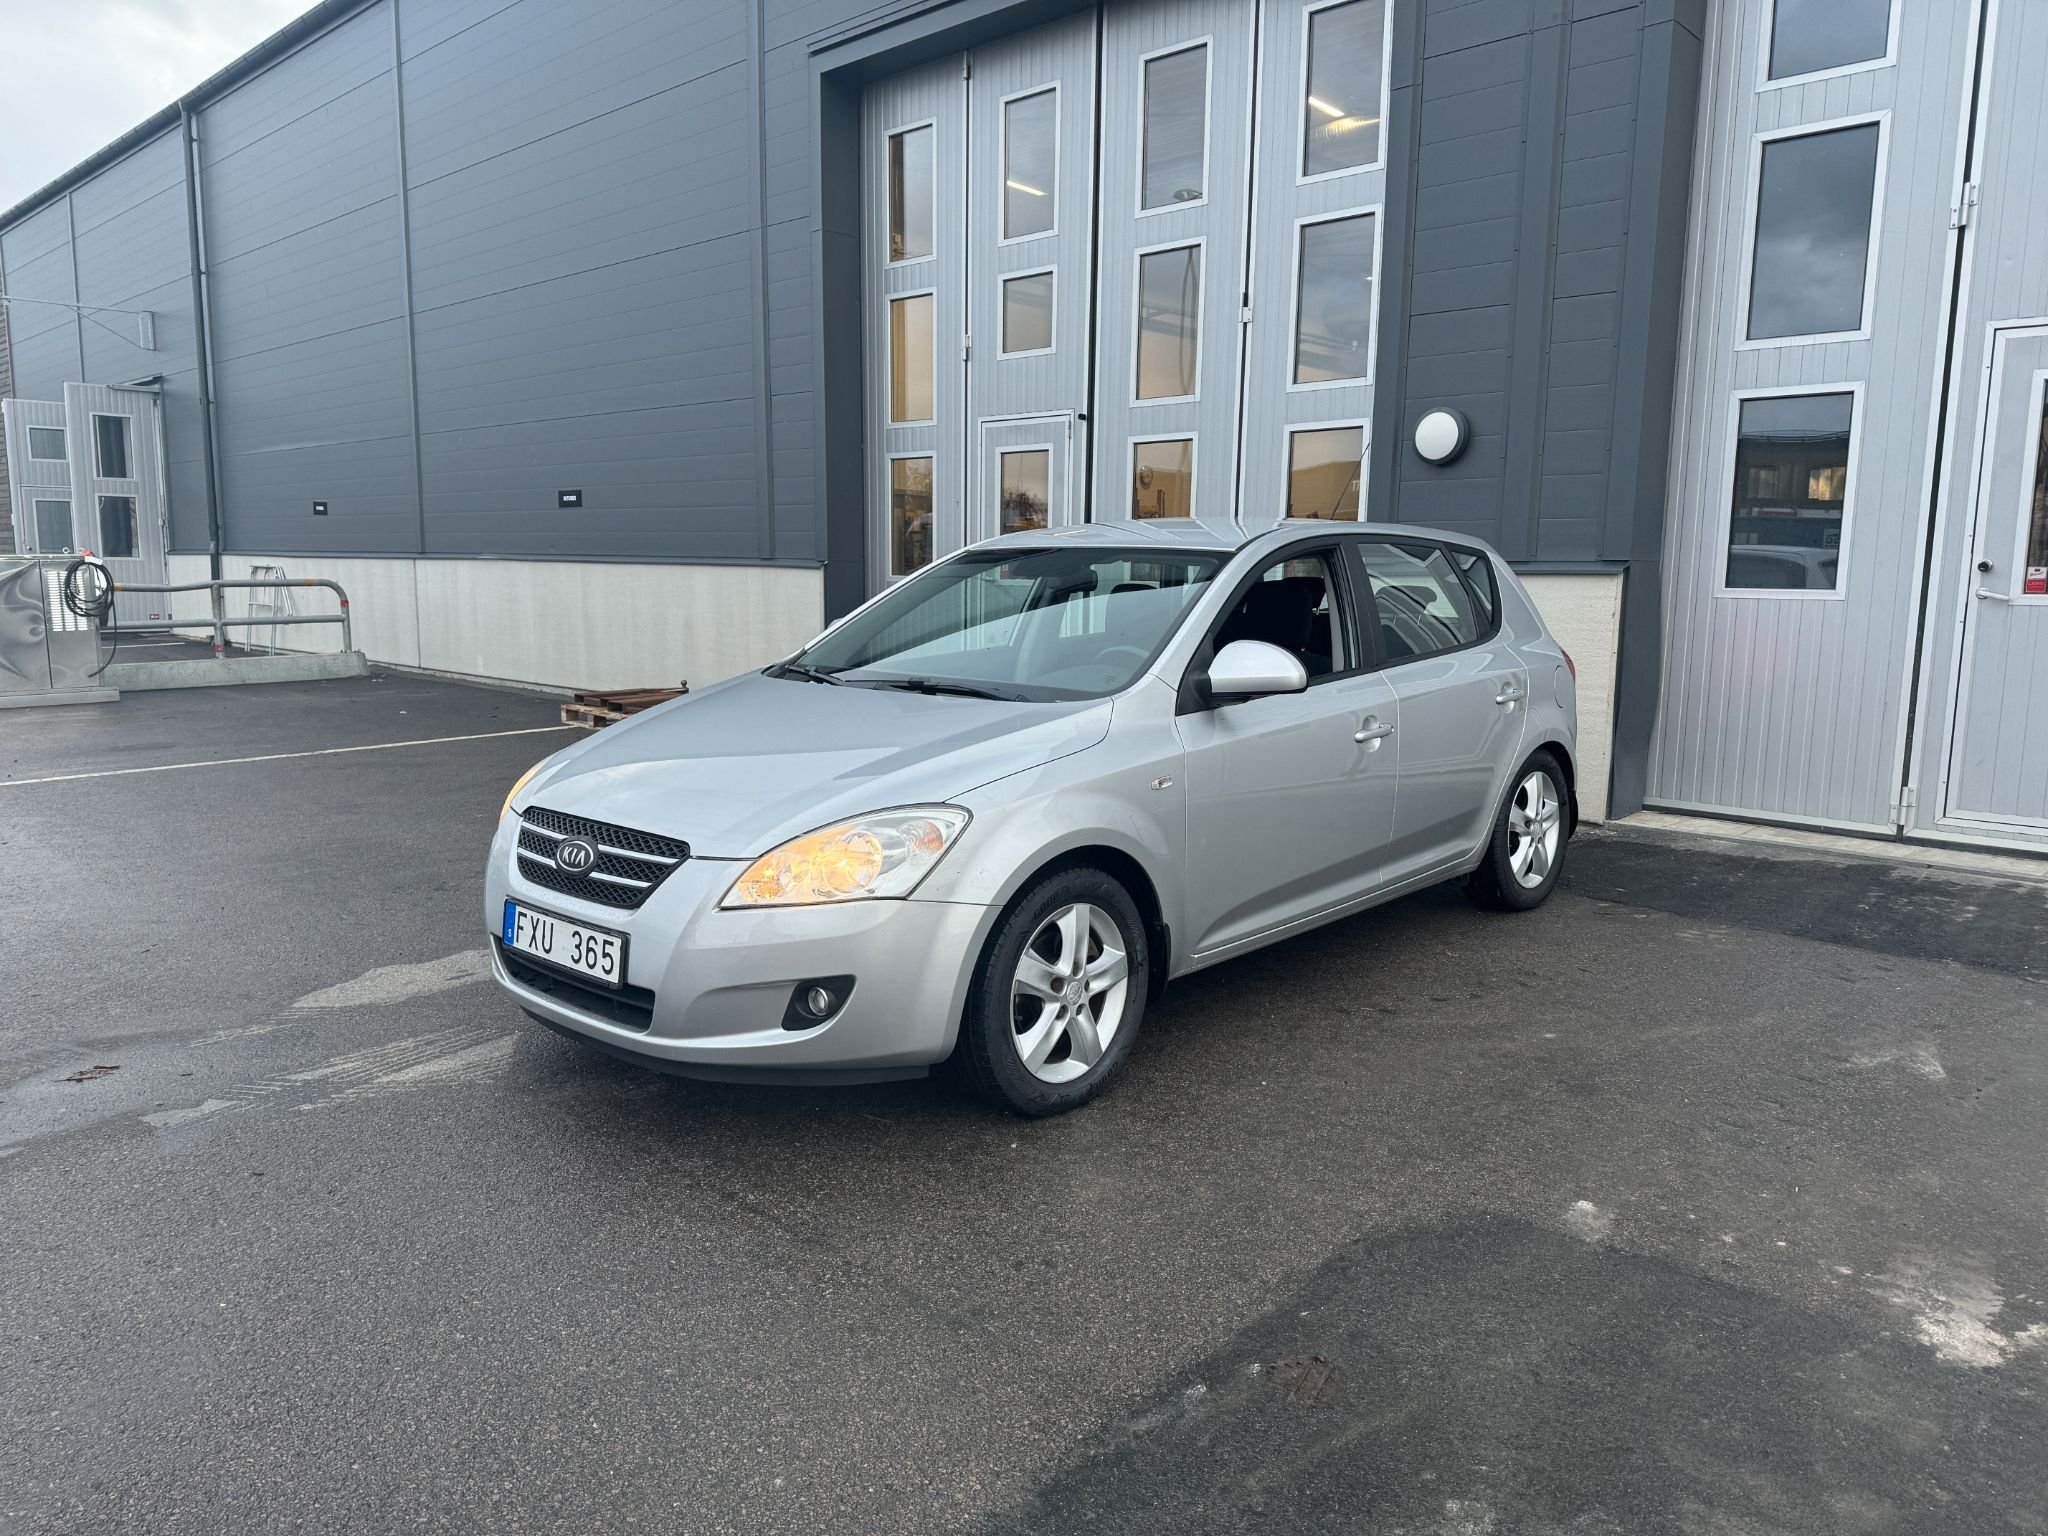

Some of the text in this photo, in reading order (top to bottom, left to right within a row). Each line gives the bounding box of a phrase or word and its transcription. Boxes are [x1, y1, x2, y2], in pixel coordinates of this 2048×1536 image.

[562, 846, 585, 866] KIA
[516, 911, 615, 975] FXU 365
